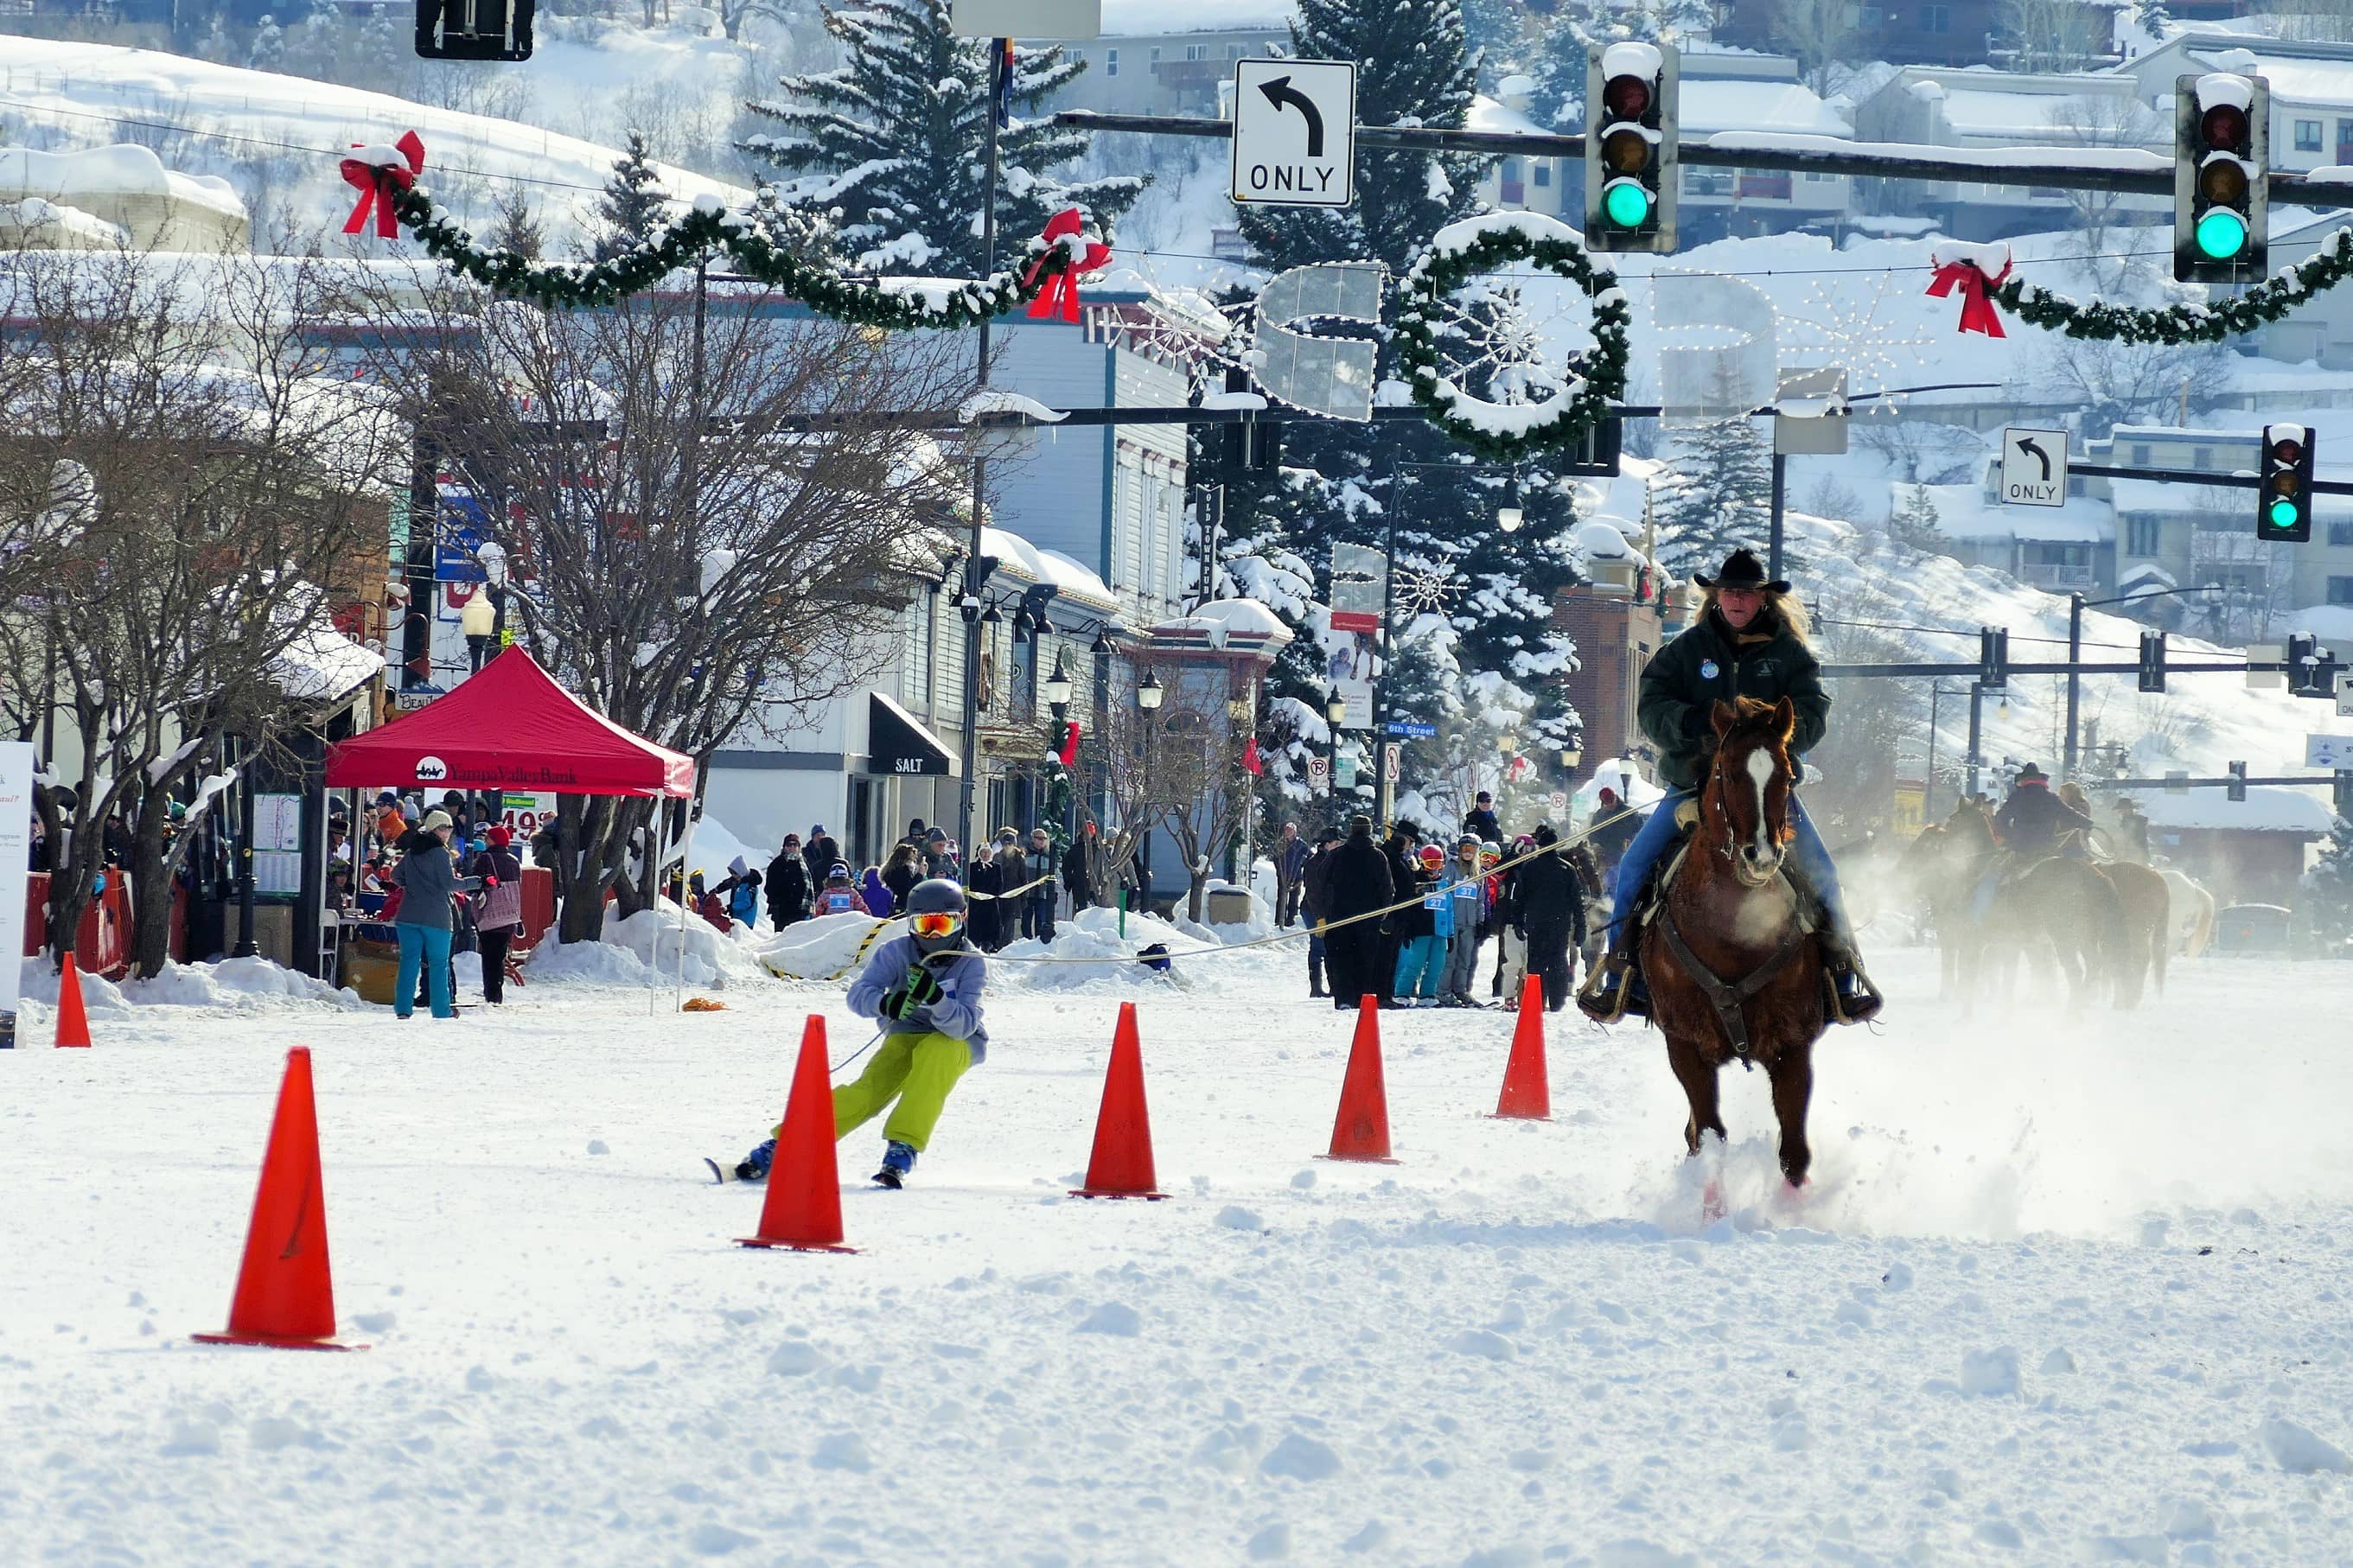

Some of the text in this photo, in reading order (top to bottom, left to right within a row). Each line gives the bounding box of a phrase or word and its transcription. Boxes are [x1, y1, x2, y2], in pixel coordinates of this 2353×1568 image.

[1250, 163, 1335, 192] ONLY
[2010, 483, 2057, 500] ONLY
[1388, 724, 1435, 736] 6th Street
[896, 757, 923, 773] SALT
[1462, 887, 1473, 896] 37
[1431, 898, 1442, 907] 27
